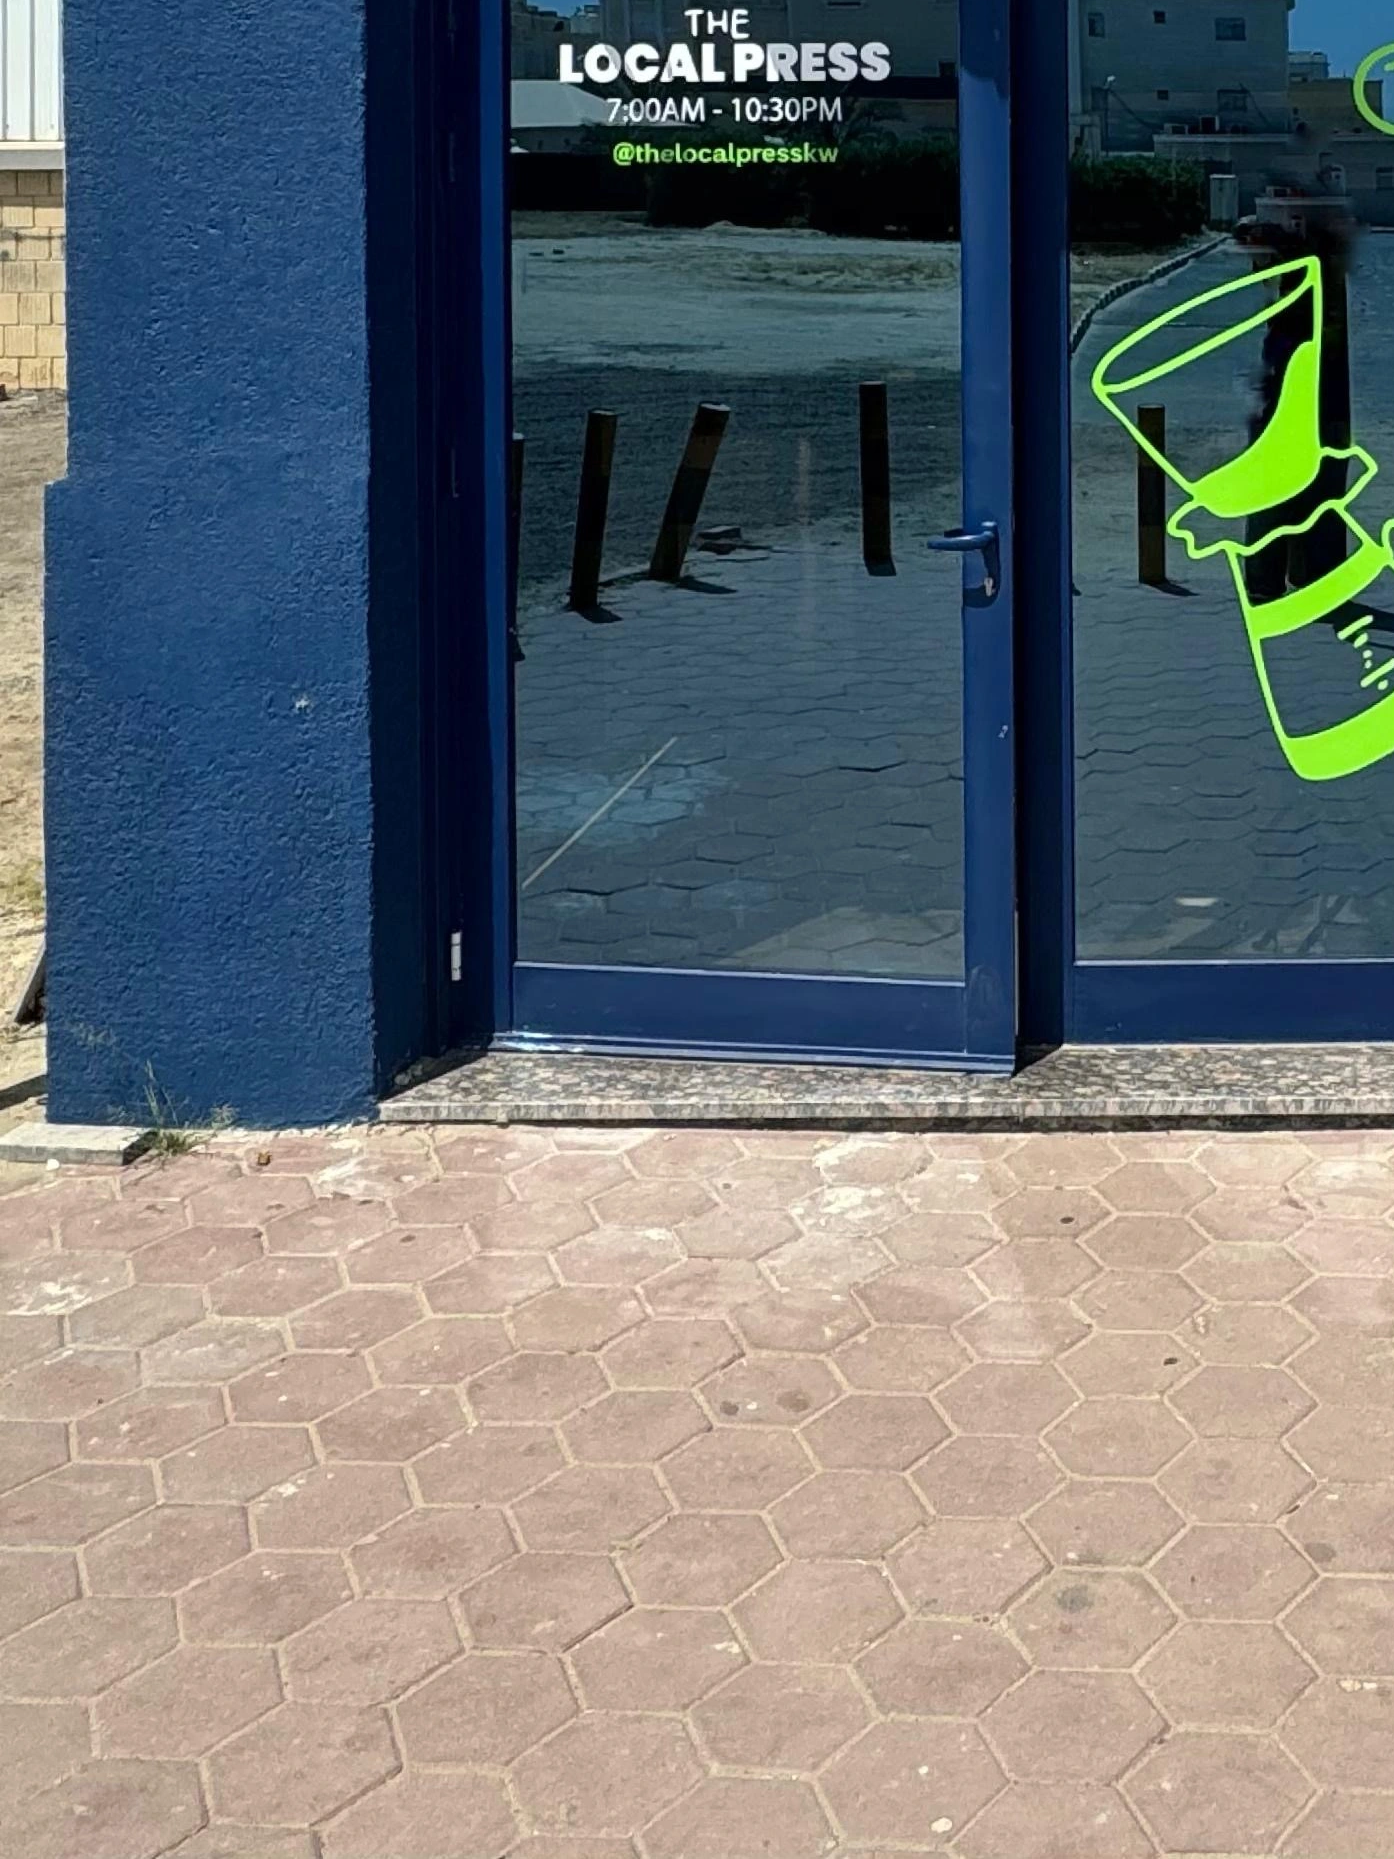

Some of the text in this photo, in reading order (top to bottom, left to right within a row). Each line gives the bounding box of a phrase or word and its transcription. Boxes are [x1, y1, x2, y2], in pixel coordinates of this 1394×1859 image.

[683, 8, 750, 39] THE
[558, 41, 892, 84] LOCAL PRESS
[605, 97, 706, 124] 7:00AM
[731, 96, 844, 124] 10:30PM
[612, 141, 840, 168] @thelocalpresskw
